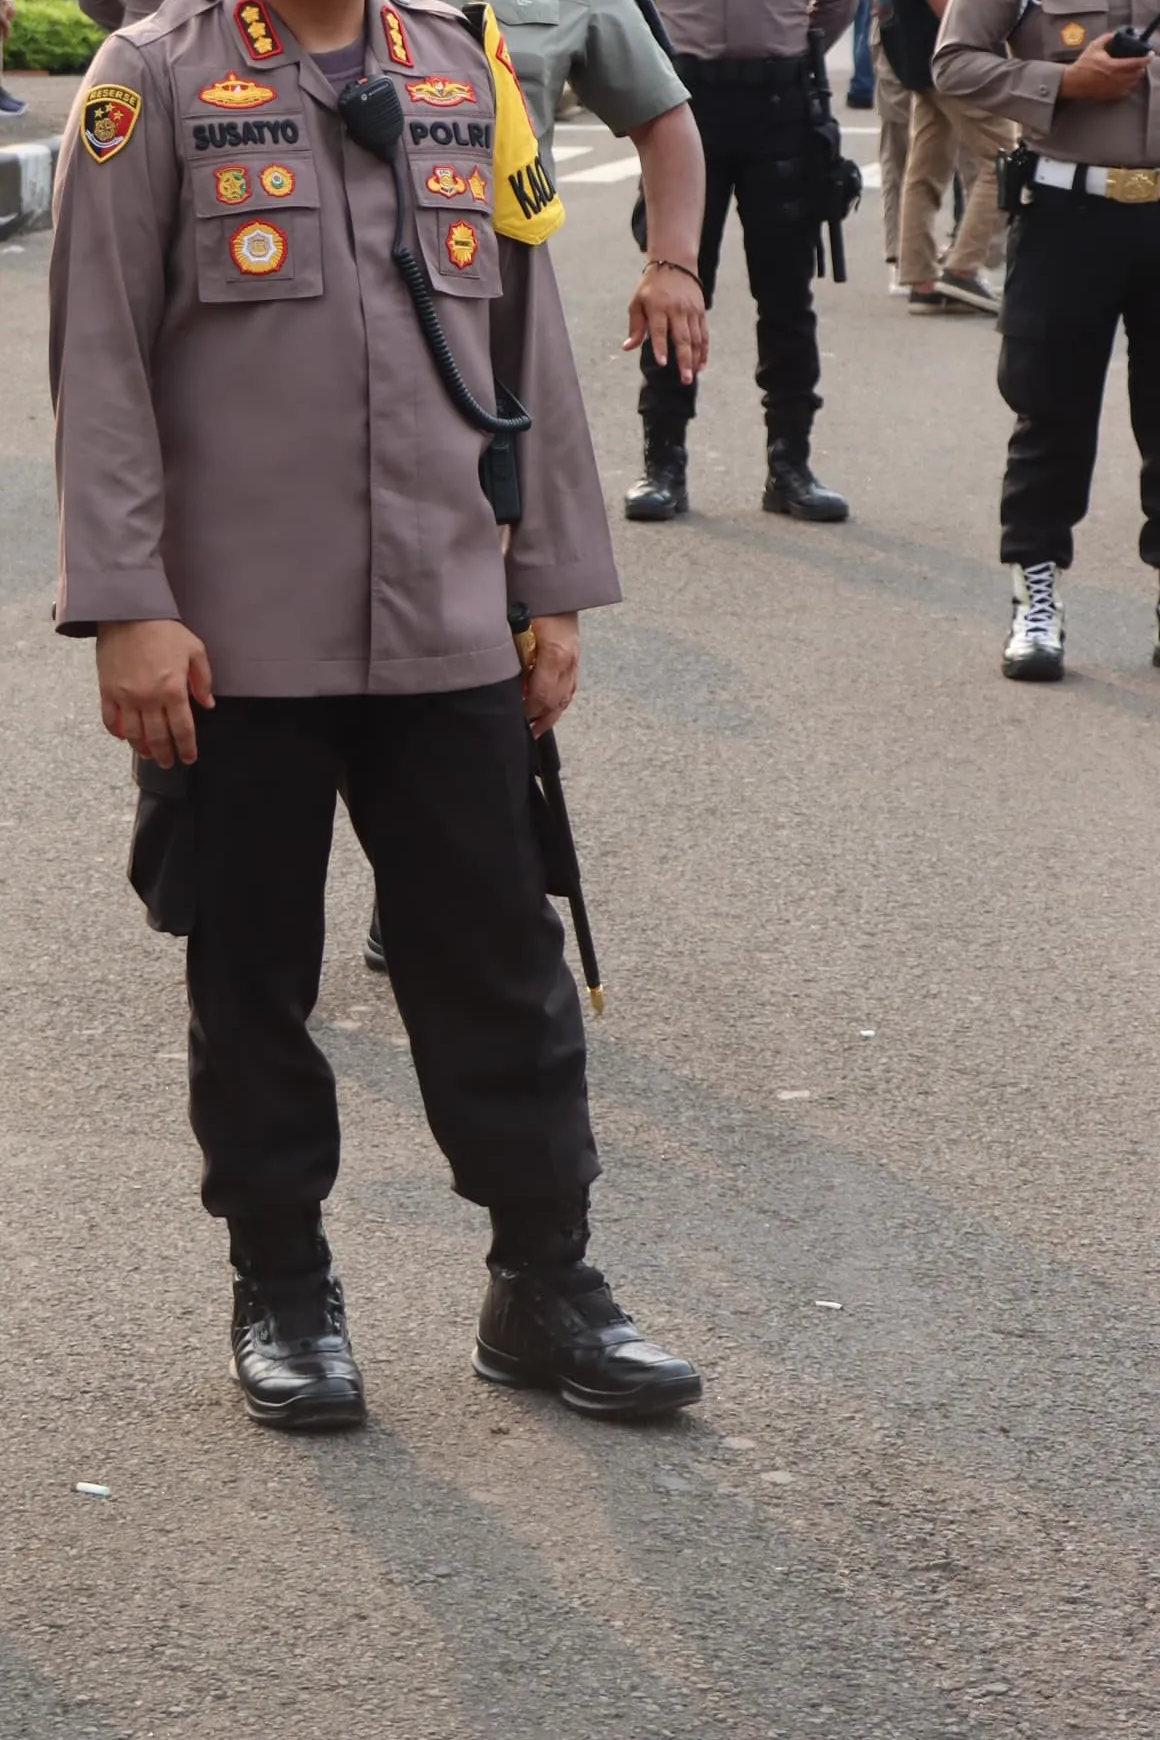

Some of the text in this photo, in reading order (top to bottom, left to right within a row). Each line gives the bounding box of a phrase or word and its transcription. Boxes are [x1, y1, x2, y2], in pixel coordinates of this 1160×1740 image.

[89, 88, 137, 107] RESERSE
[193, 119, 299, 151] SUSATYO
[409, 120, 490, 149] POLRI
